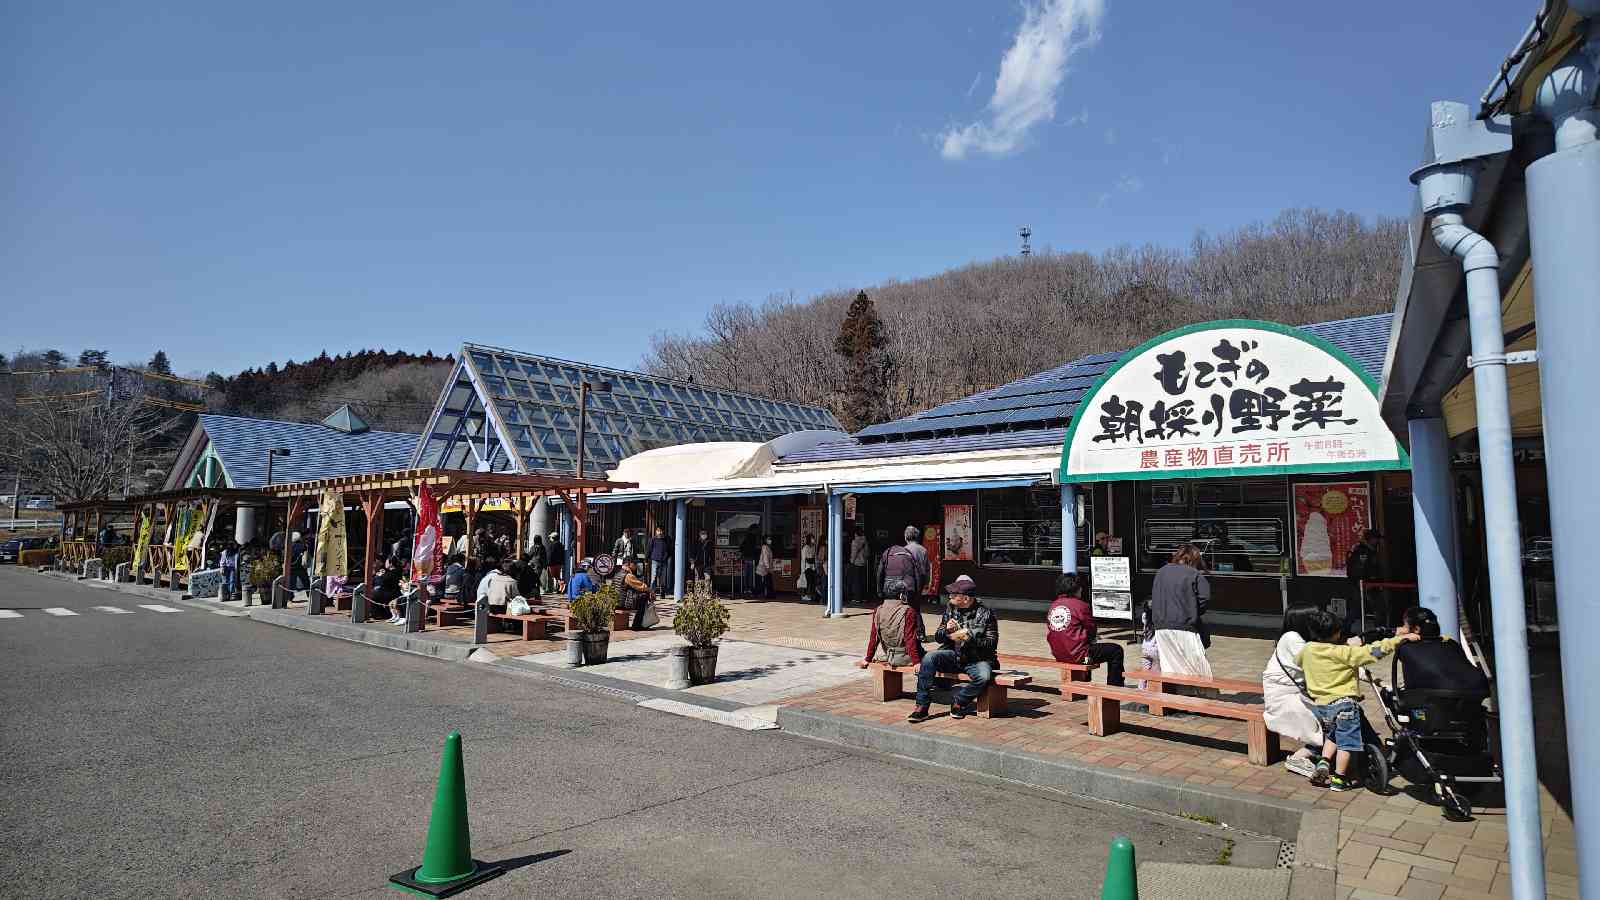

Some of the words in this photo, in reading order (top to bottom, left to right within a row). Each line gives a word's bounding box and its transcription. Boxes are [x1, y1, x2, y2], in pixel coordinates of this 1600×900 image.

[1153, 338, 1270, 395] もてぎの
[1091, 375, 1359, 444] 朝採り野菜
[1139, 441, 1291, 469] 農産物直売所
